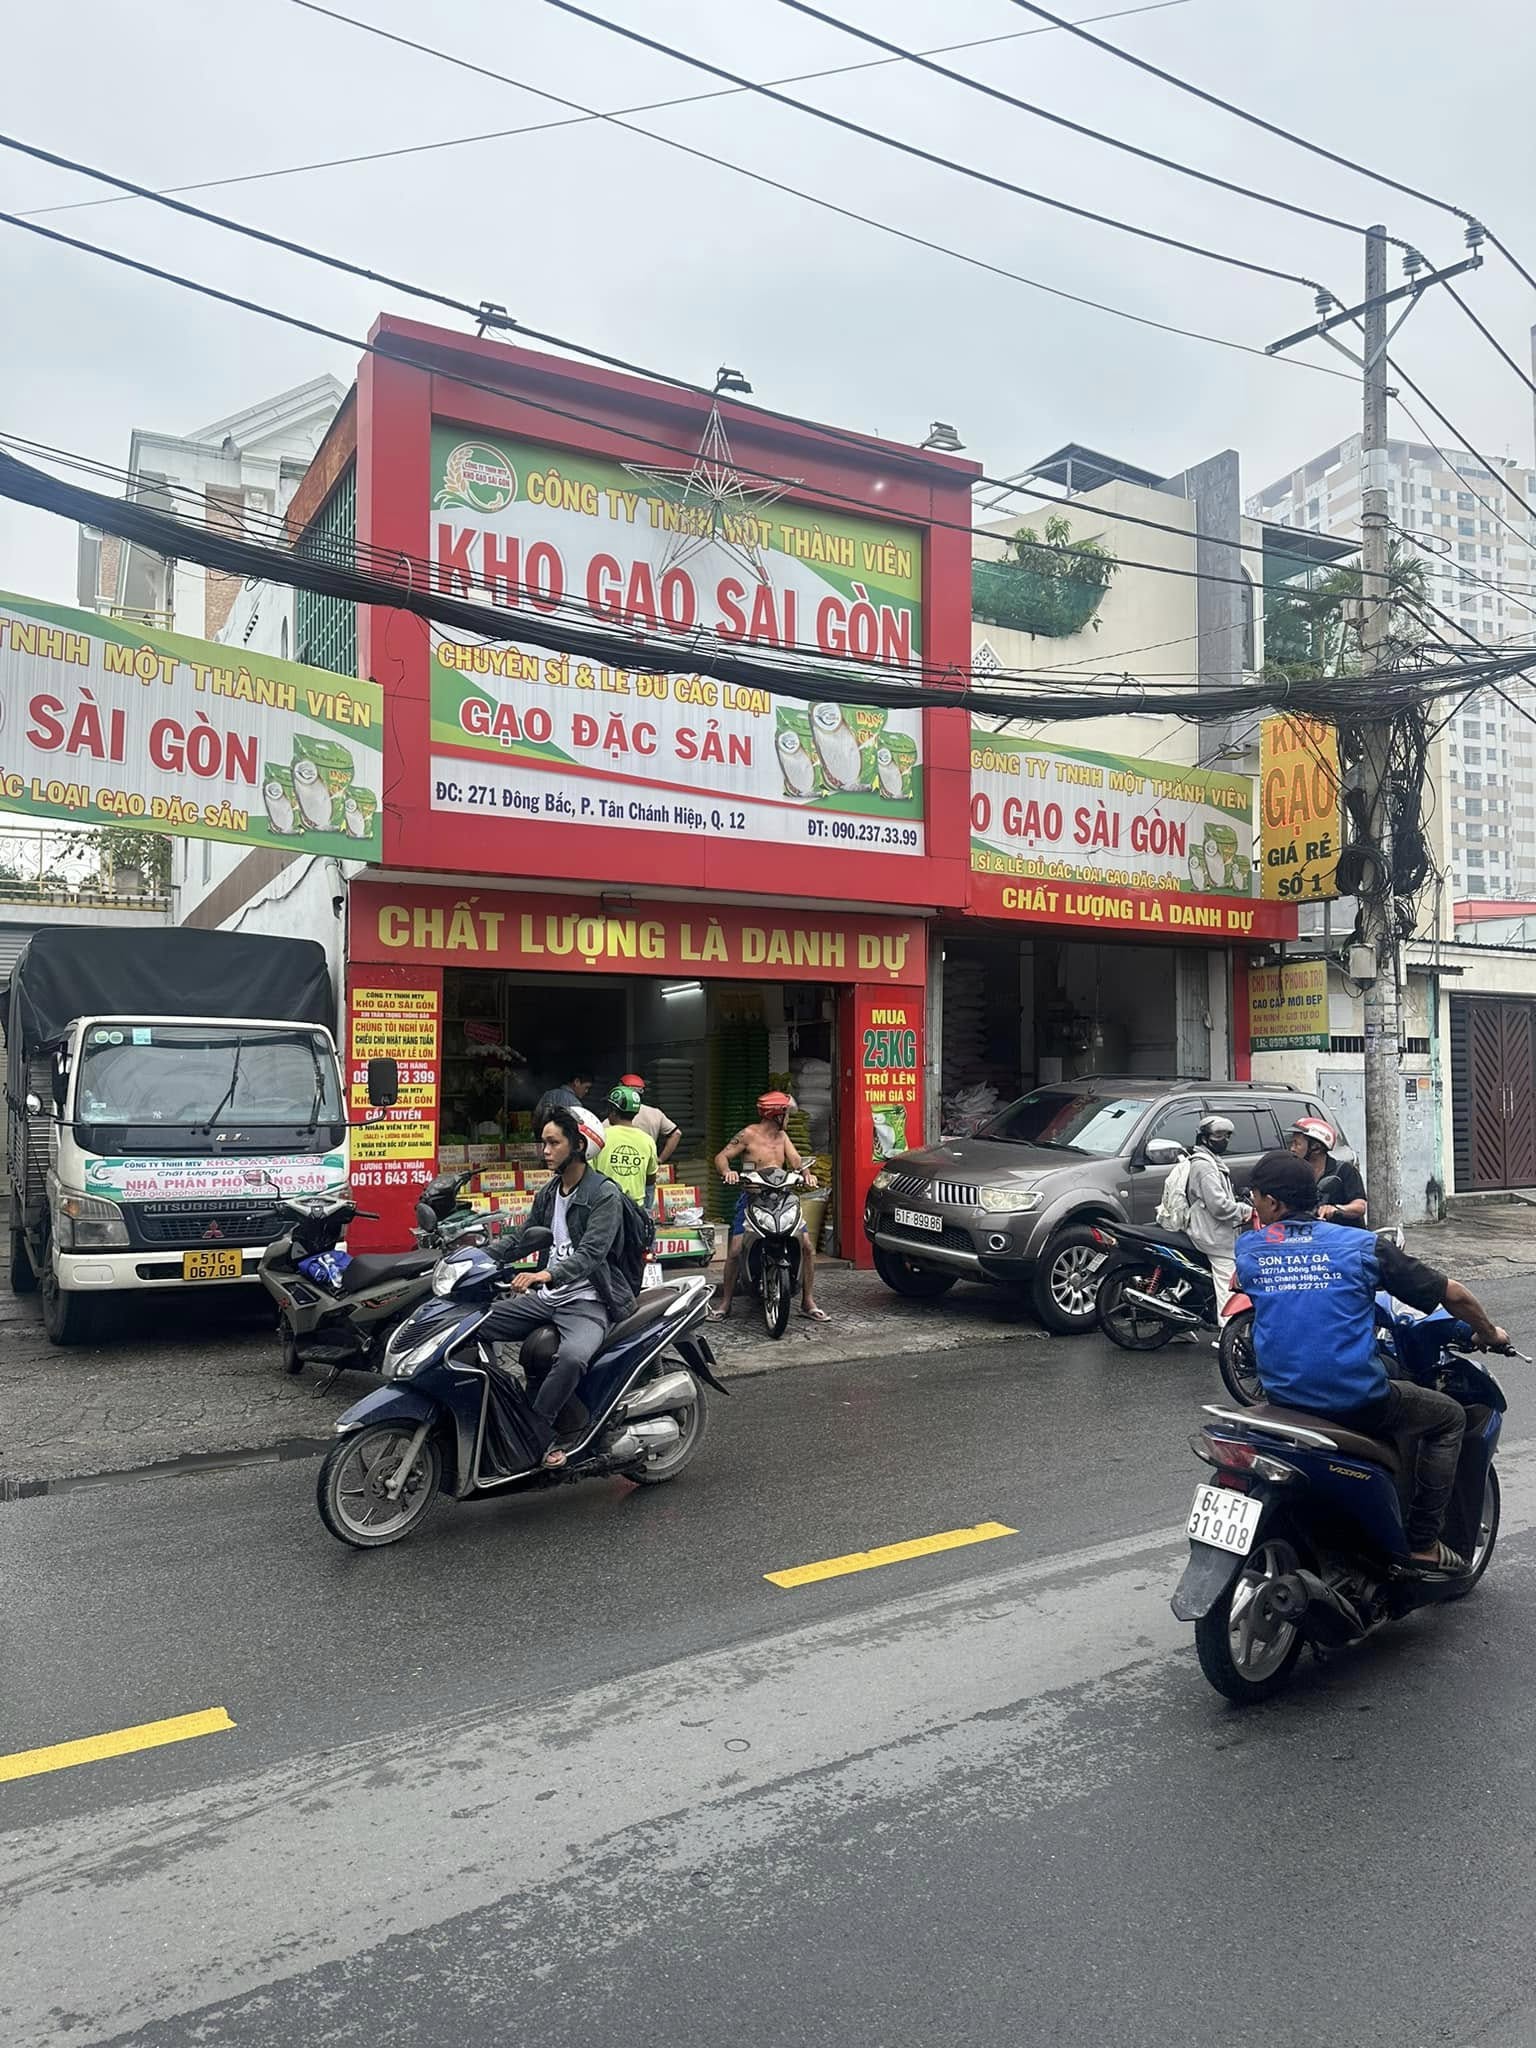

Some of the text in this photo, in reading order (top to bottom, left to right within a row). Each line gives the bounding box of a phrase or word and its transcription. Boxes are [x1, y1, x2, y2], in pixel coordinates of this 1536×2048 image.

[526, 468, 599, 517] CÔNG
[605, 487, 640, 524] TY
[779, 523, 855, 569] THÀNH
[862, 539, 912, 579] VIÊN
[438, 523, 564, 613] KHO
[715, 566, 796, 650] SÀI
[816, 584, 910, 667] GÒN
[104, 642, 372, 728] MỘT THÀNH VIÊN
[437, 641, 771, 718] CHUYÊN SỈ & CÁC LOẠI
[26, 686, 259, 785] SÀI GÒN
[460, 699, 752, 767] GẠO ĐẶC SẢN
[1271, 717, 1329, 756] KHO
[970, 747, 1248, 811] CÔNG TY TNHH MỘT THÀNH VIÊN
[31, 778, 248, 832] LOẠI GẠO ĐẶC SẢN
[436, 781, 746, 831] ĐC: 271 Đông Bắc, P. Tân Chánh Hiệp, Q. 12
[1263, 757, 1337, 838] GẠO
[807, 819, 917, 847] ĐT: 090.237.33.99
[1003, 797, 1186, 857] GẠO SÀI GÒN
[1267, 831, 1332, 867] GIÁ RẺ
[994, 858, 1004, 872] &
[1008, 854, 1023, 874] LẺ
[1027, 857, 1044, 876] ĐỦ
[1048, 859, 1072, 879] CÁC
[1076, 864, 1102, 885] LOẠI
[1106, 869, 1129, 889] GẠO
[1158, 871, 1181, 891] SẢN
[1311, 873, 1322, 892] 1
[1002, 882, 1255, 935] CHẤT LƯỢNG LÀ DANH DỰ
[378, 897, 910, 979] CHẤT LƯỢNG LÀ DANH DỰ
[355, 1000, 375, 1008] KHO
[377, 1000, 396, 1010] GẠO
[871, 1009, 907, 1025] MUA
[1252, 999, 1268, 1010] CAO
[355, 1020, 434, 1033] CHÚNG TÔI NGHỈ VÀO
[356, 1047, 366, 1057] VÀ
[367, 1047, 384, 1057] CÁC
[386, 1047, 407, 1057] NGÀY
[863, 1028, 917, 1069] 25KG
[412, 1070, 435, 1083] 399
[864, 1070, 916, 1085] TRỞ LÊN
[414, 1096, 433, 1105] GÒN
[865, 1088, 886, 1102] TÍNH
[888, 1088, 904, 1102] GIÁ
[390, 1107, 422, 1120] TUYỂN
[124, 1161, 147, 1169] CÔNG
[149, 1160, 159, 1168] TY
[162, 1160, 183, 1168] TNHH
[185, 1160, 202, 1168] MTV
[351, 1170, 433, 1187] 0913 643 354
[126, 1177, 158, 1190] NHÀ
[190, 1264, 236, 1279] 067.09
[200, 1252, 226, 1265] 51C
[1258, 1253, 1330, 1266] SƠN TAY GA
[1313, 1282, 1329, 1290] 217
[1328, 1463, 1373, 1481] VISION
[1201, 1491, 1249, 1523] 64-F1
[1189, 1512, 1250, 1549] 319.08
